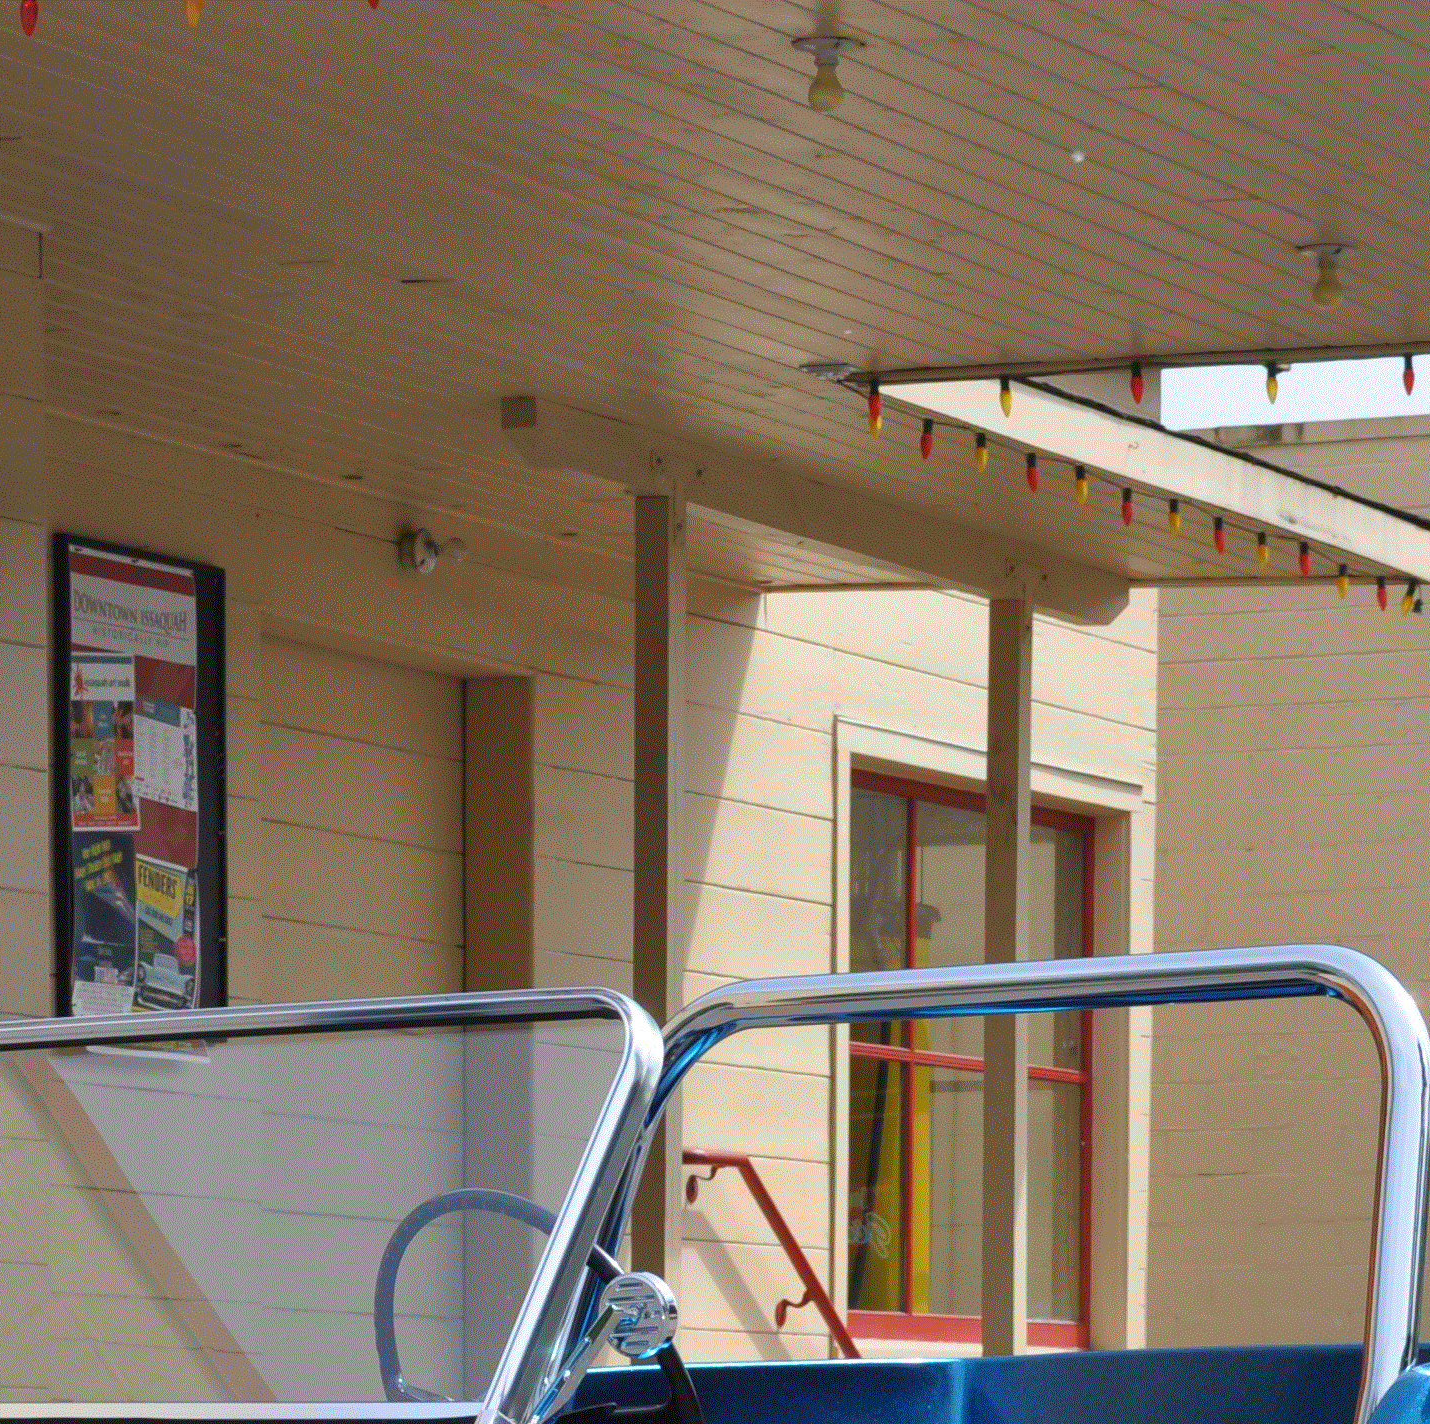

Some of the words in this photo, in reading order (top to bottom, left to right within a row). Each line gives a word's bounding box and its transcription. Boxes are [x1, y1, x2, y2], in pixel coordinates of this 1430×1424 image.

[73, 588, 138, 624] DOWNTOWN
[141, 609, 187, 637] ISSAQUAH
[138, 864, 178, 899] FENDERS
